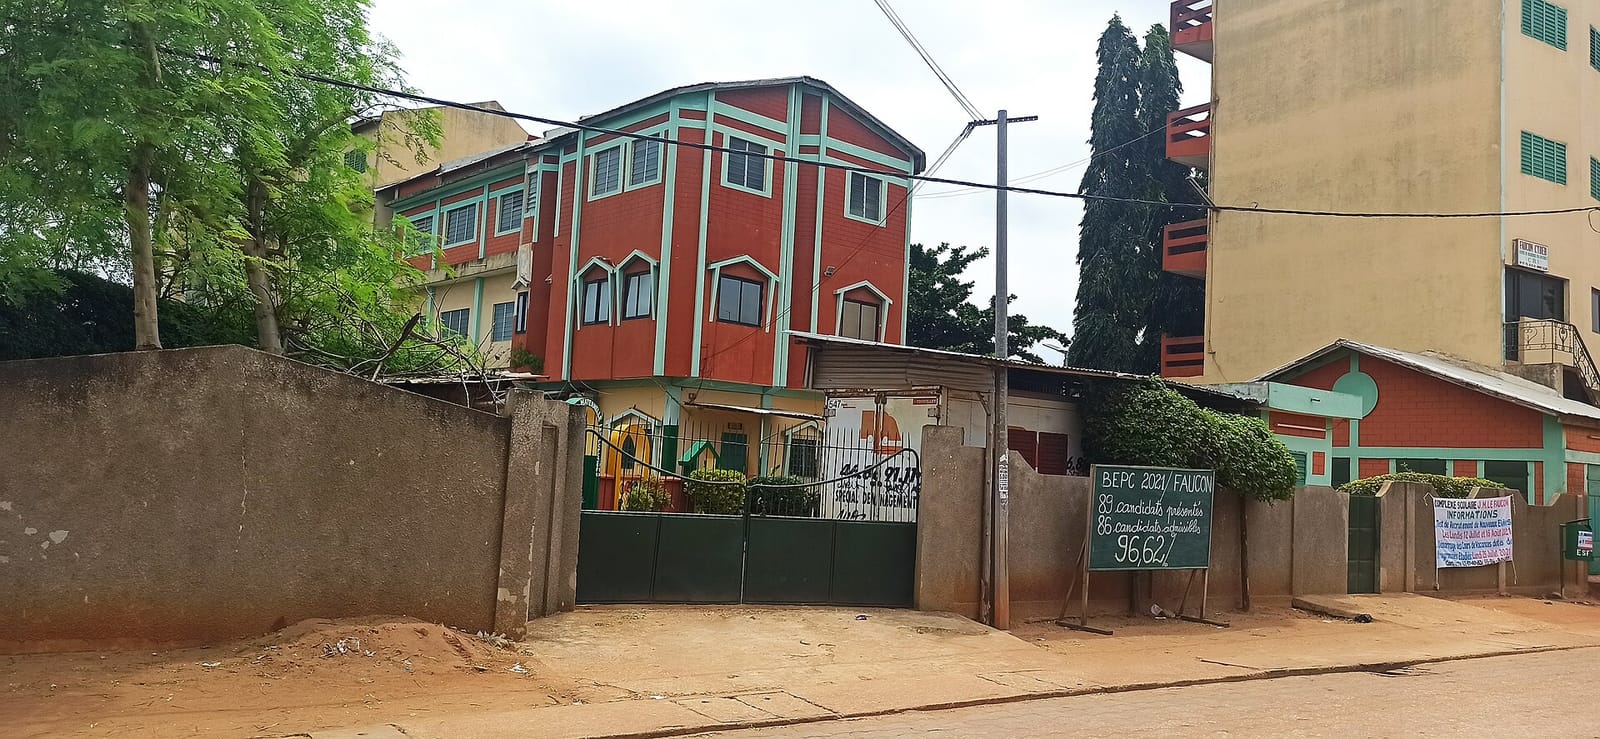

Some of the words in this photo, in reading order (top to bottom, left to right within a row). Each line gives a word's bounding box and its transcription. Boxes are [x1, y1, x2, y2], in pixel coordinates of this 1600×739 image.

[1102, 471, 1135, 489] BEPC
[1174, 474, 1212, 493] FAUCON
[1098, 494, 1114, 514] 89
[1114, 500, 1164, 516] candidats
[1446, 510, 1498, 520] INFORMATIONS
[1098, 515, 1112, 536] 86
[1112, 519, 1162, 534] candidats
